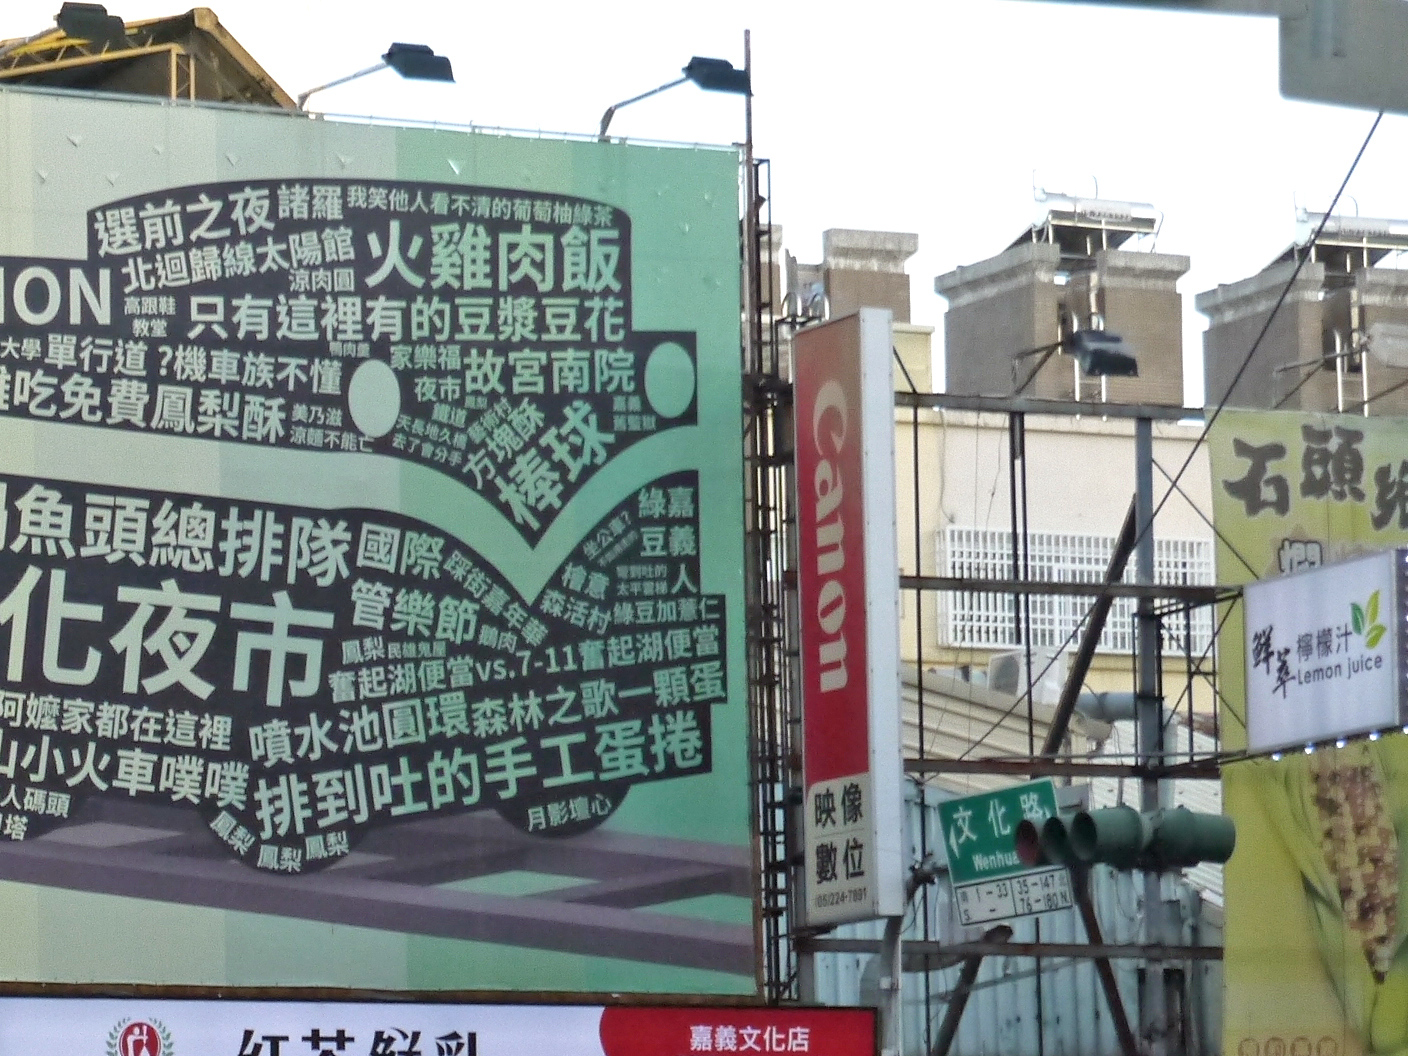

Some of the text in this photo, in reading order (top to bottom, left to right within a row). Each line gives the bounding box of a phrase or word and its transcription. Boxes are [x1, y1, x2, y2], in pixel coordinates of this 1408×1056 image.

[94, 185, 275, 258] 選前之夜
[278, 184, 344, 221] 諸羅
[347, 185, 613, 227] 我笑他人看不清的葡萄柚綠茶
[122, 226, 355, 295] 北迴歸線太陽館
[290, 267, 355, 292] 涼肉圓
[364, 219, 621, 294] 火雞肉飯
[124, 295, 176, 316] 高跟鞋
[132, 317, 168, 338] 教堂
[188, 295, 625, 343] 只有這裡有的豆漿豆花
[390, 344, 461, 371] 家樂福
[464, 348, 635, 396] 故宮南院
[414, 375, 462, 403] 夜市
[462, 397, 545, 490] 方塊酥
[494, 399, 616, 530] 棒球
[357, 521, 446, 582] 國際
[813, 380, 849, 694] Canon
[349, 577, 481, 645] 管樂節
[1297, 623, 1353, 664] 檸檬汁
[1297, 654, 1383, 686] Lemon juice
[254, 710, 703, 841] 排到吐的手工蛋捲
[815, 782, 863, 828] 映像
[953, 792, 1042, 845] 文化路
[210, 810, 256, 856] 鳳梨
[305, 830, 349, 861] 鳳梨
[257, 844, 302, 873] 鳳梨
[816, 838, 864, 884] 數位
[690, 1024, 811, 1053] 嘉義文化店
